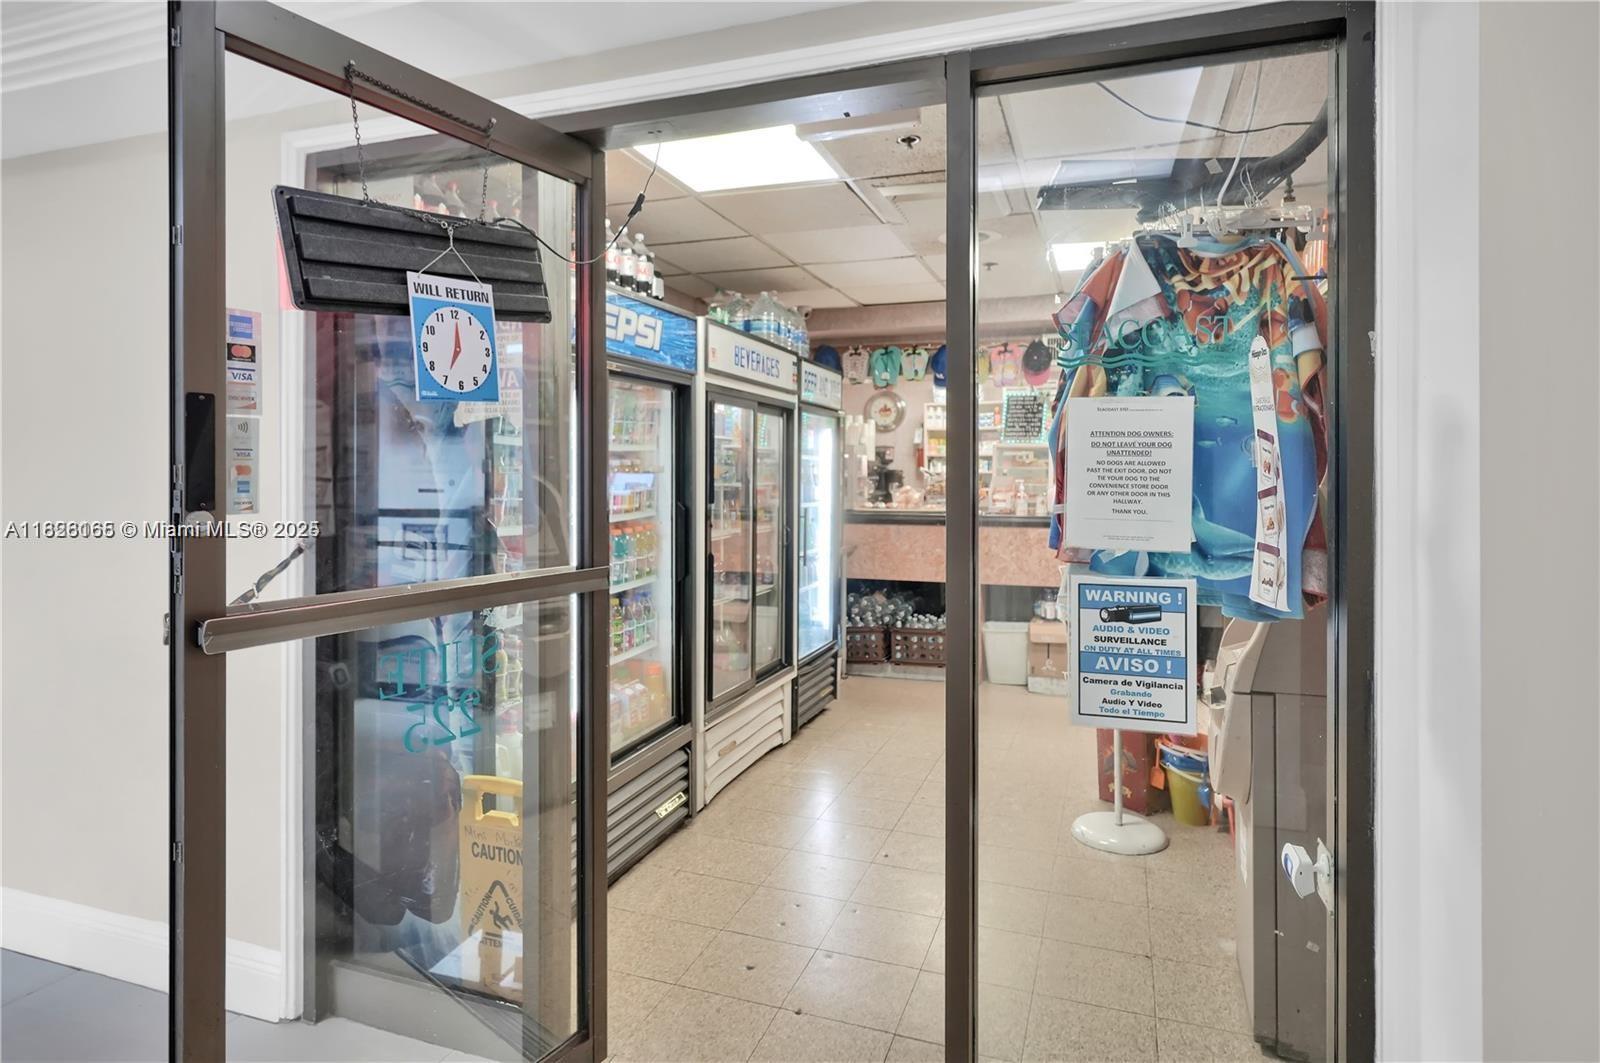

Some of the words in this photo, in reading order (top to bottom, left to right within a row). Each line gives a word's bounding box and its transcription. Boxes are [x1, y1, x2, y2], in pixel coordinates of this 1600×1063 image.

[413, 282, 442, 297] WILL
[445, 286, 489, 303] RETURN
[435, 313, 444, 322] 11
[450, 310, 459, 320] 12
[468, 316, 472, 326] 1
[425, 325, 436, 335] 10
[606, 302, 663, 352] EPSI
[480, 330, 485, 340] 2
[422, 342, 428, 352] 9
[485, 348, 490, 357] 3
[429, 361, 435, 371] 8
[734, 345, 780, 378] BEVERAGES
[482, 364, 487, 374] 4
[231, 372, 253, 381] VISA
[443, 375, 448, 385] 7
[473, 377, 478, 386] 5
[459, 380, 464, 390] 6
[1090, 430, 1126, 438] ATTENTION
[1085, 589, 1172, 604] WARNING
[1177, 592, 1183, 605] !
[1092, 624, 1124, 633] AUDIO
[1138, 626, 1170, 635] VIDEO
[1094, 635, 1167, 646] SURVEILLANCE
[1084, 644, 1096, 652] ON
[1155, 649, 1182, 657] TIMES
[1095, 656, 1159, 674] AVISO
[1166, 660, 1172, 674] !
[1082, 676, 1119, 686] Camera
[1121, 679, 1133, 687] de
[1135, 680, 1184, 691] Vigilancia
[1110, 688, 1152, 698] Grabando
[1102, 697, 1126, 706] Audio
[1137, 700, 1163, 708] Video
[1098, 706, 1120, 714] Todo
[1122, 707, 1130, 715] el
[1132, 709, 1165, 718] Tiempo
[471, 841, 524, 866] CAUTION
[471, 891, 494, 926] CAUTION
